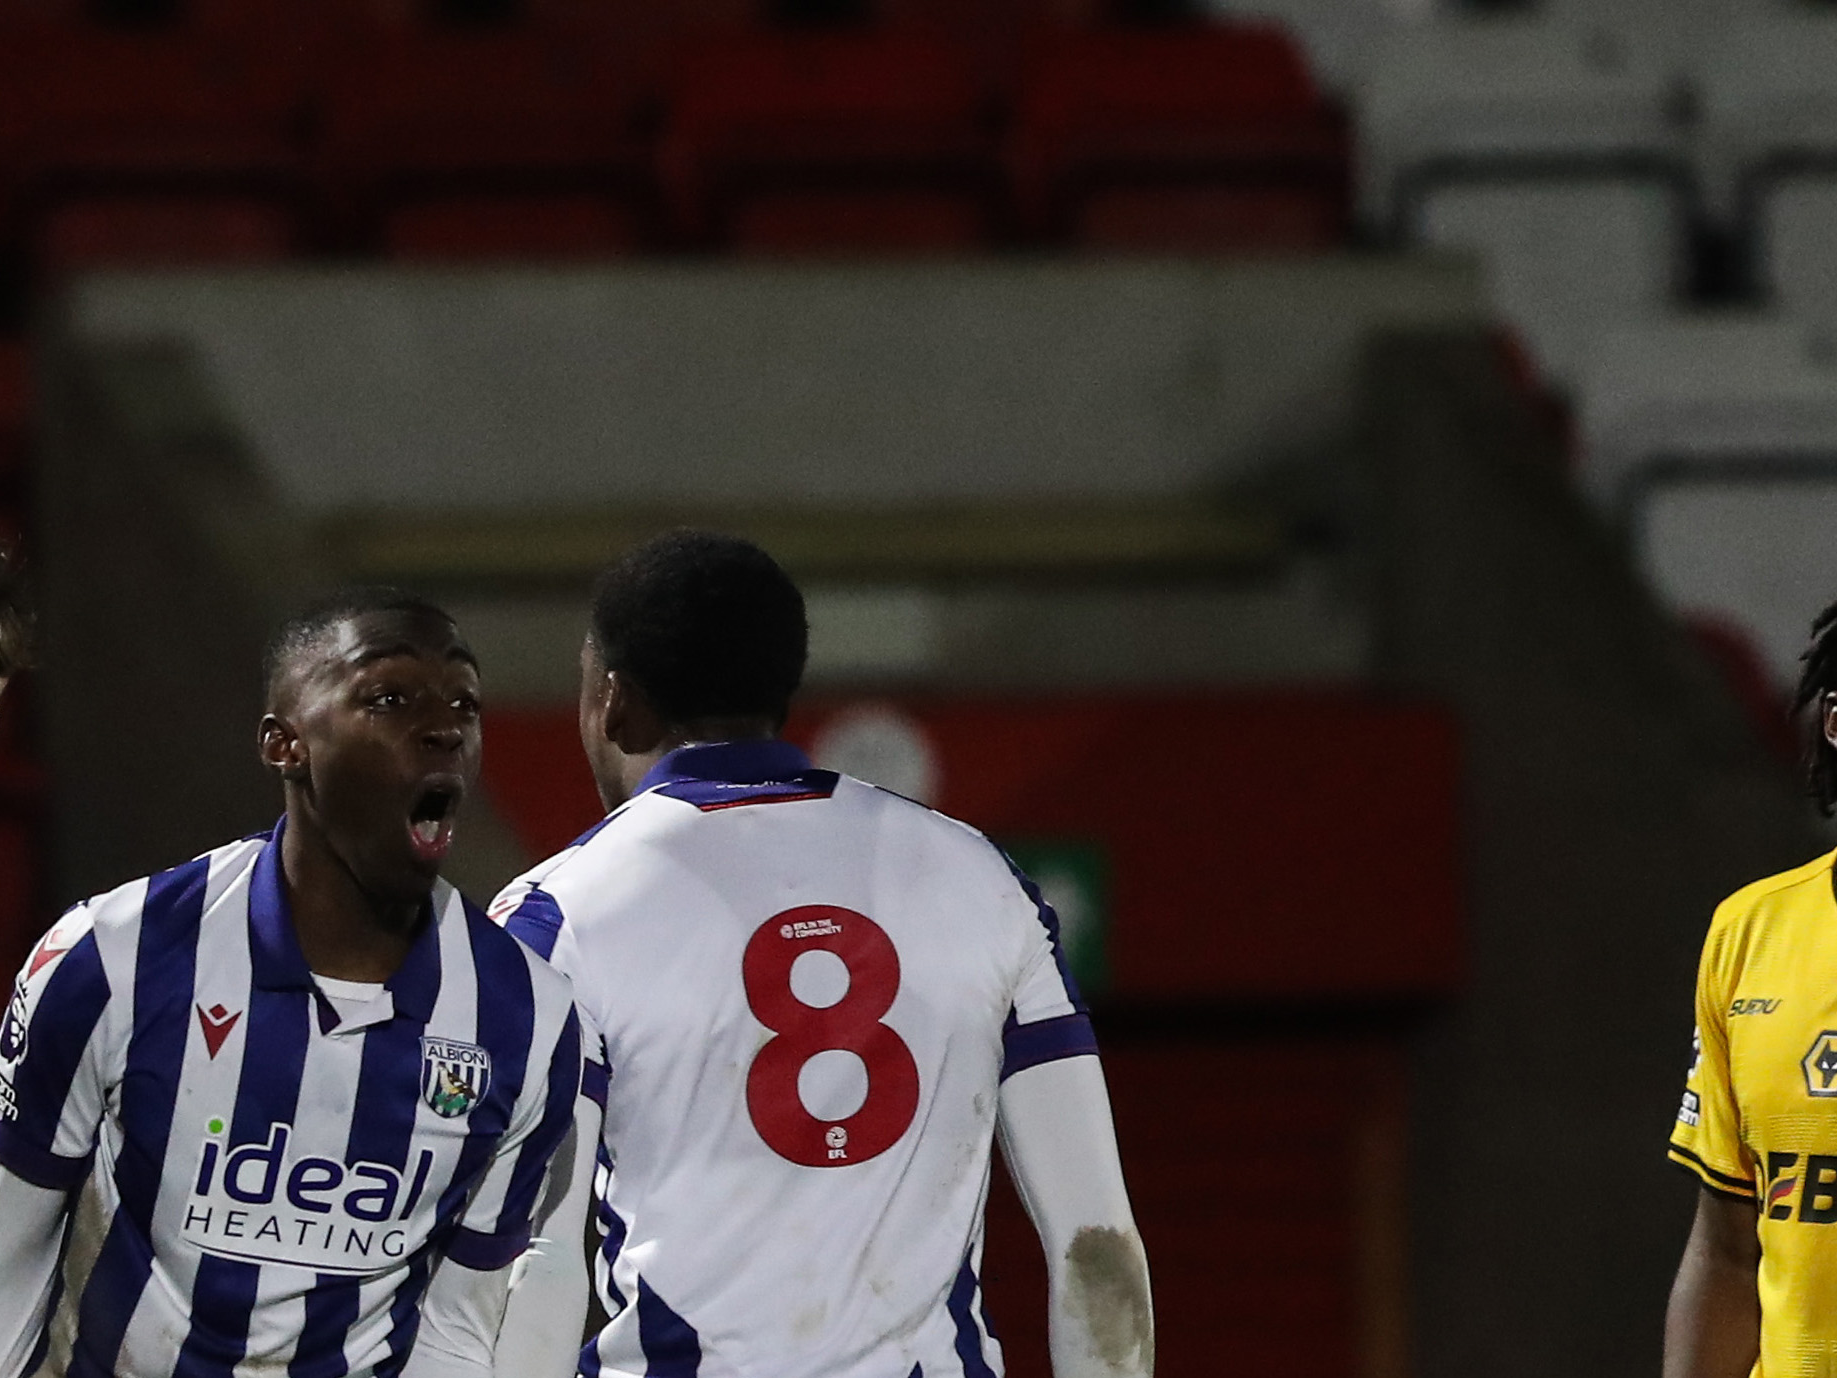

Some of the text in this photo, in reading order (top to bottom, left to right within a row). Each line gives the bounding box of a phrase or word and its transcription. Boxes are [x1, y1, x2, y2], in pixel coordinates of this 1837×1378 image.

[427, 1045, 486, 1067] ALBION
[742, 904, 920, 1168] 8
[195, 1118, 434, 1223] ideal
[183, 1205, 405, 1258] HEATING
